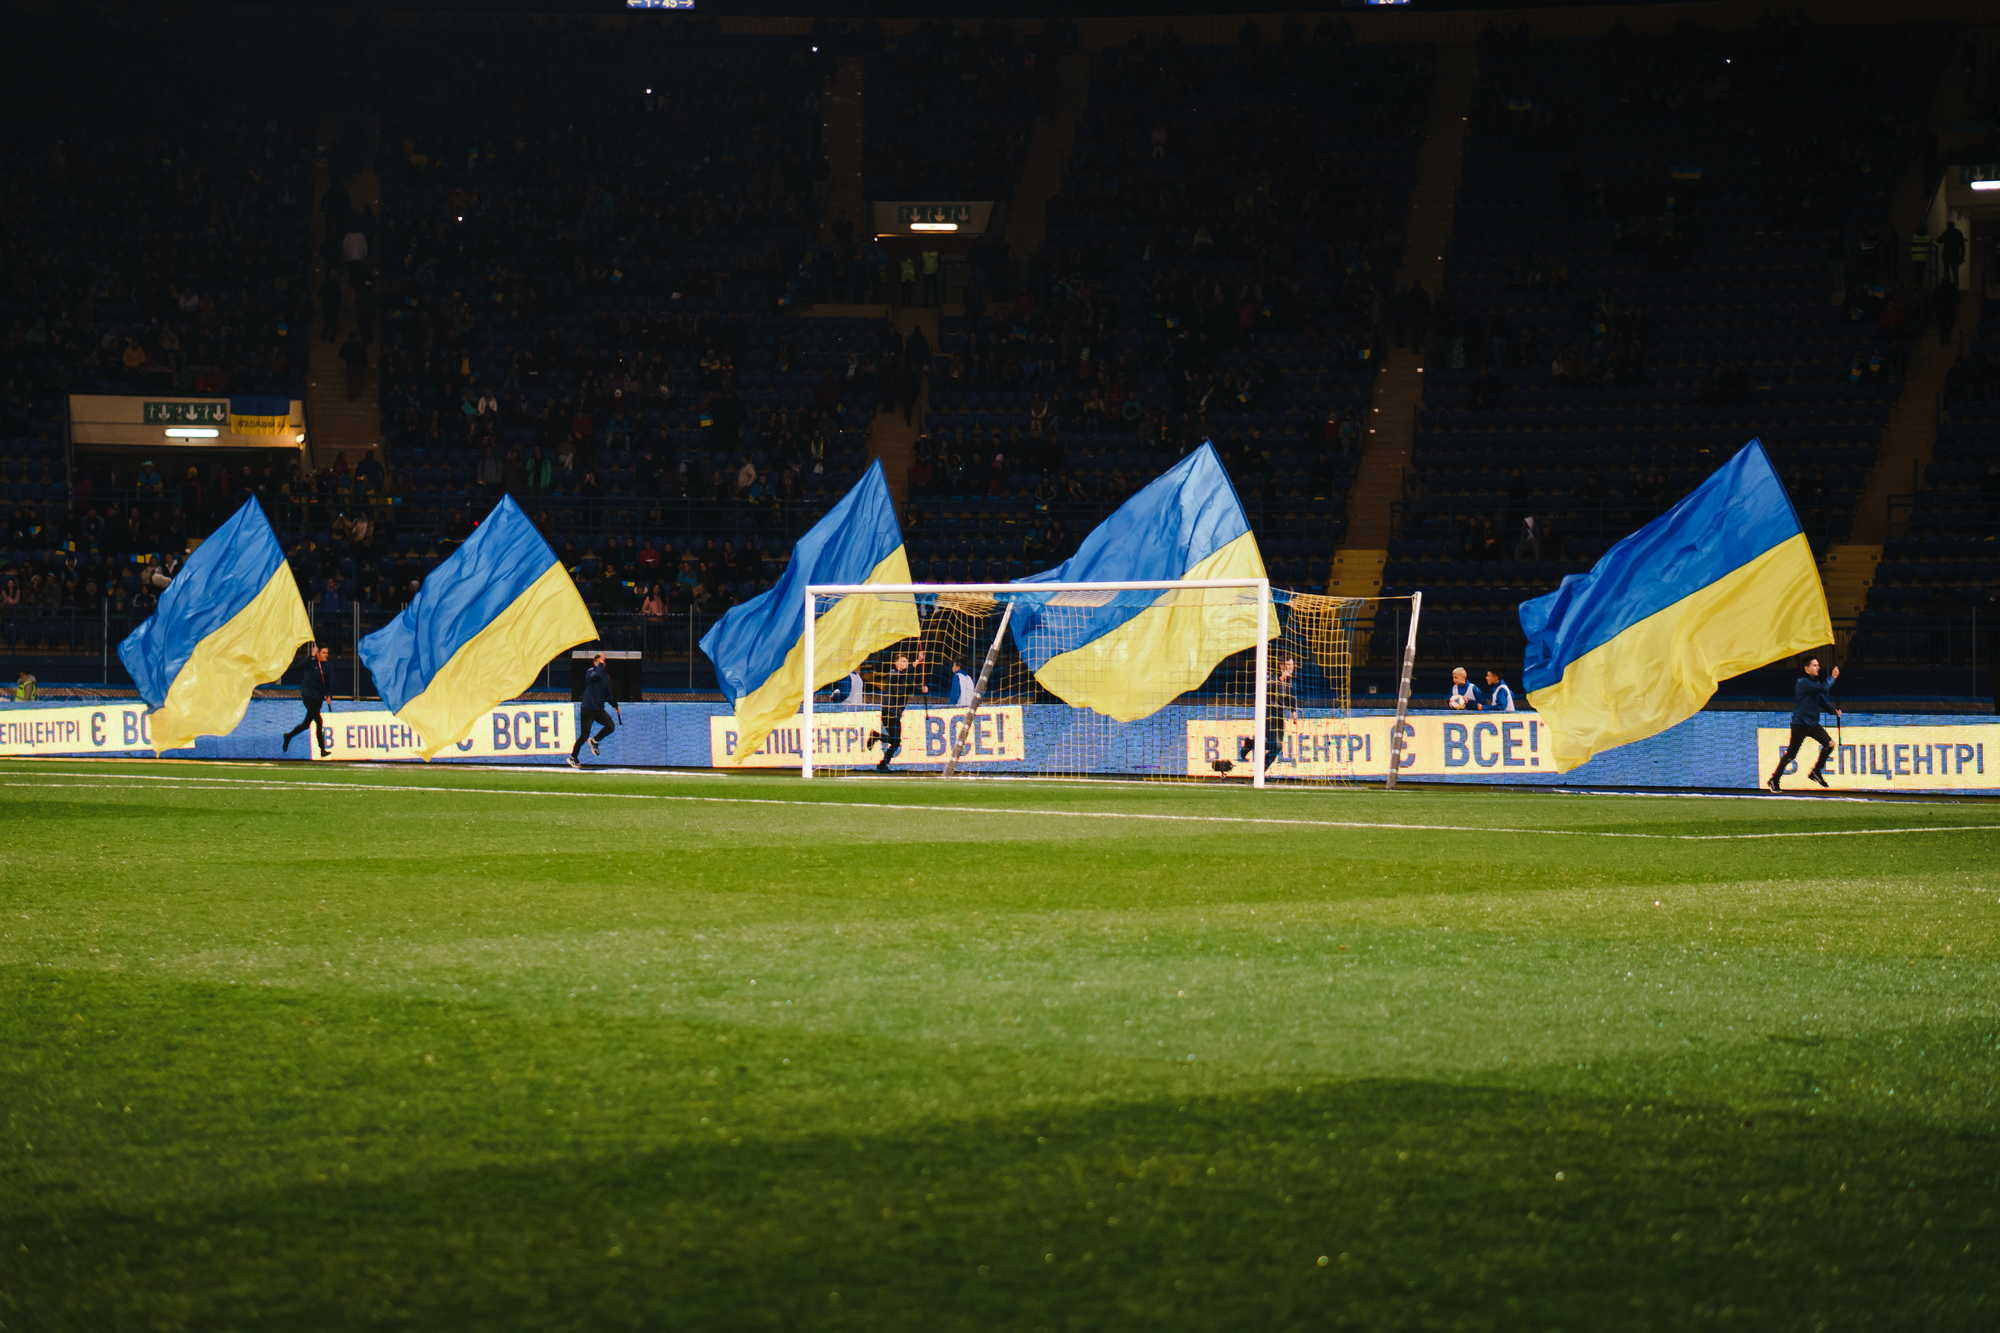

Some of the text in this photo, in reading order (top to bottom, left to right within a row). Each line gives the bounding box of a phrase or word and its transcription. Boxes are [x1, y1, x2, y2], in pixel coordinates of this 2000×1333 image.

[91, 712, 107, 746] Є
[123, 710, 152, 745] ВС
[346, 724, 421, 752] ЕПІЦЕН
[492, 710, 561, 750] ВСЕ!
[1204, 736, 1219, 762] В
[1443, 720, 1539, 767] ВСЕ!
